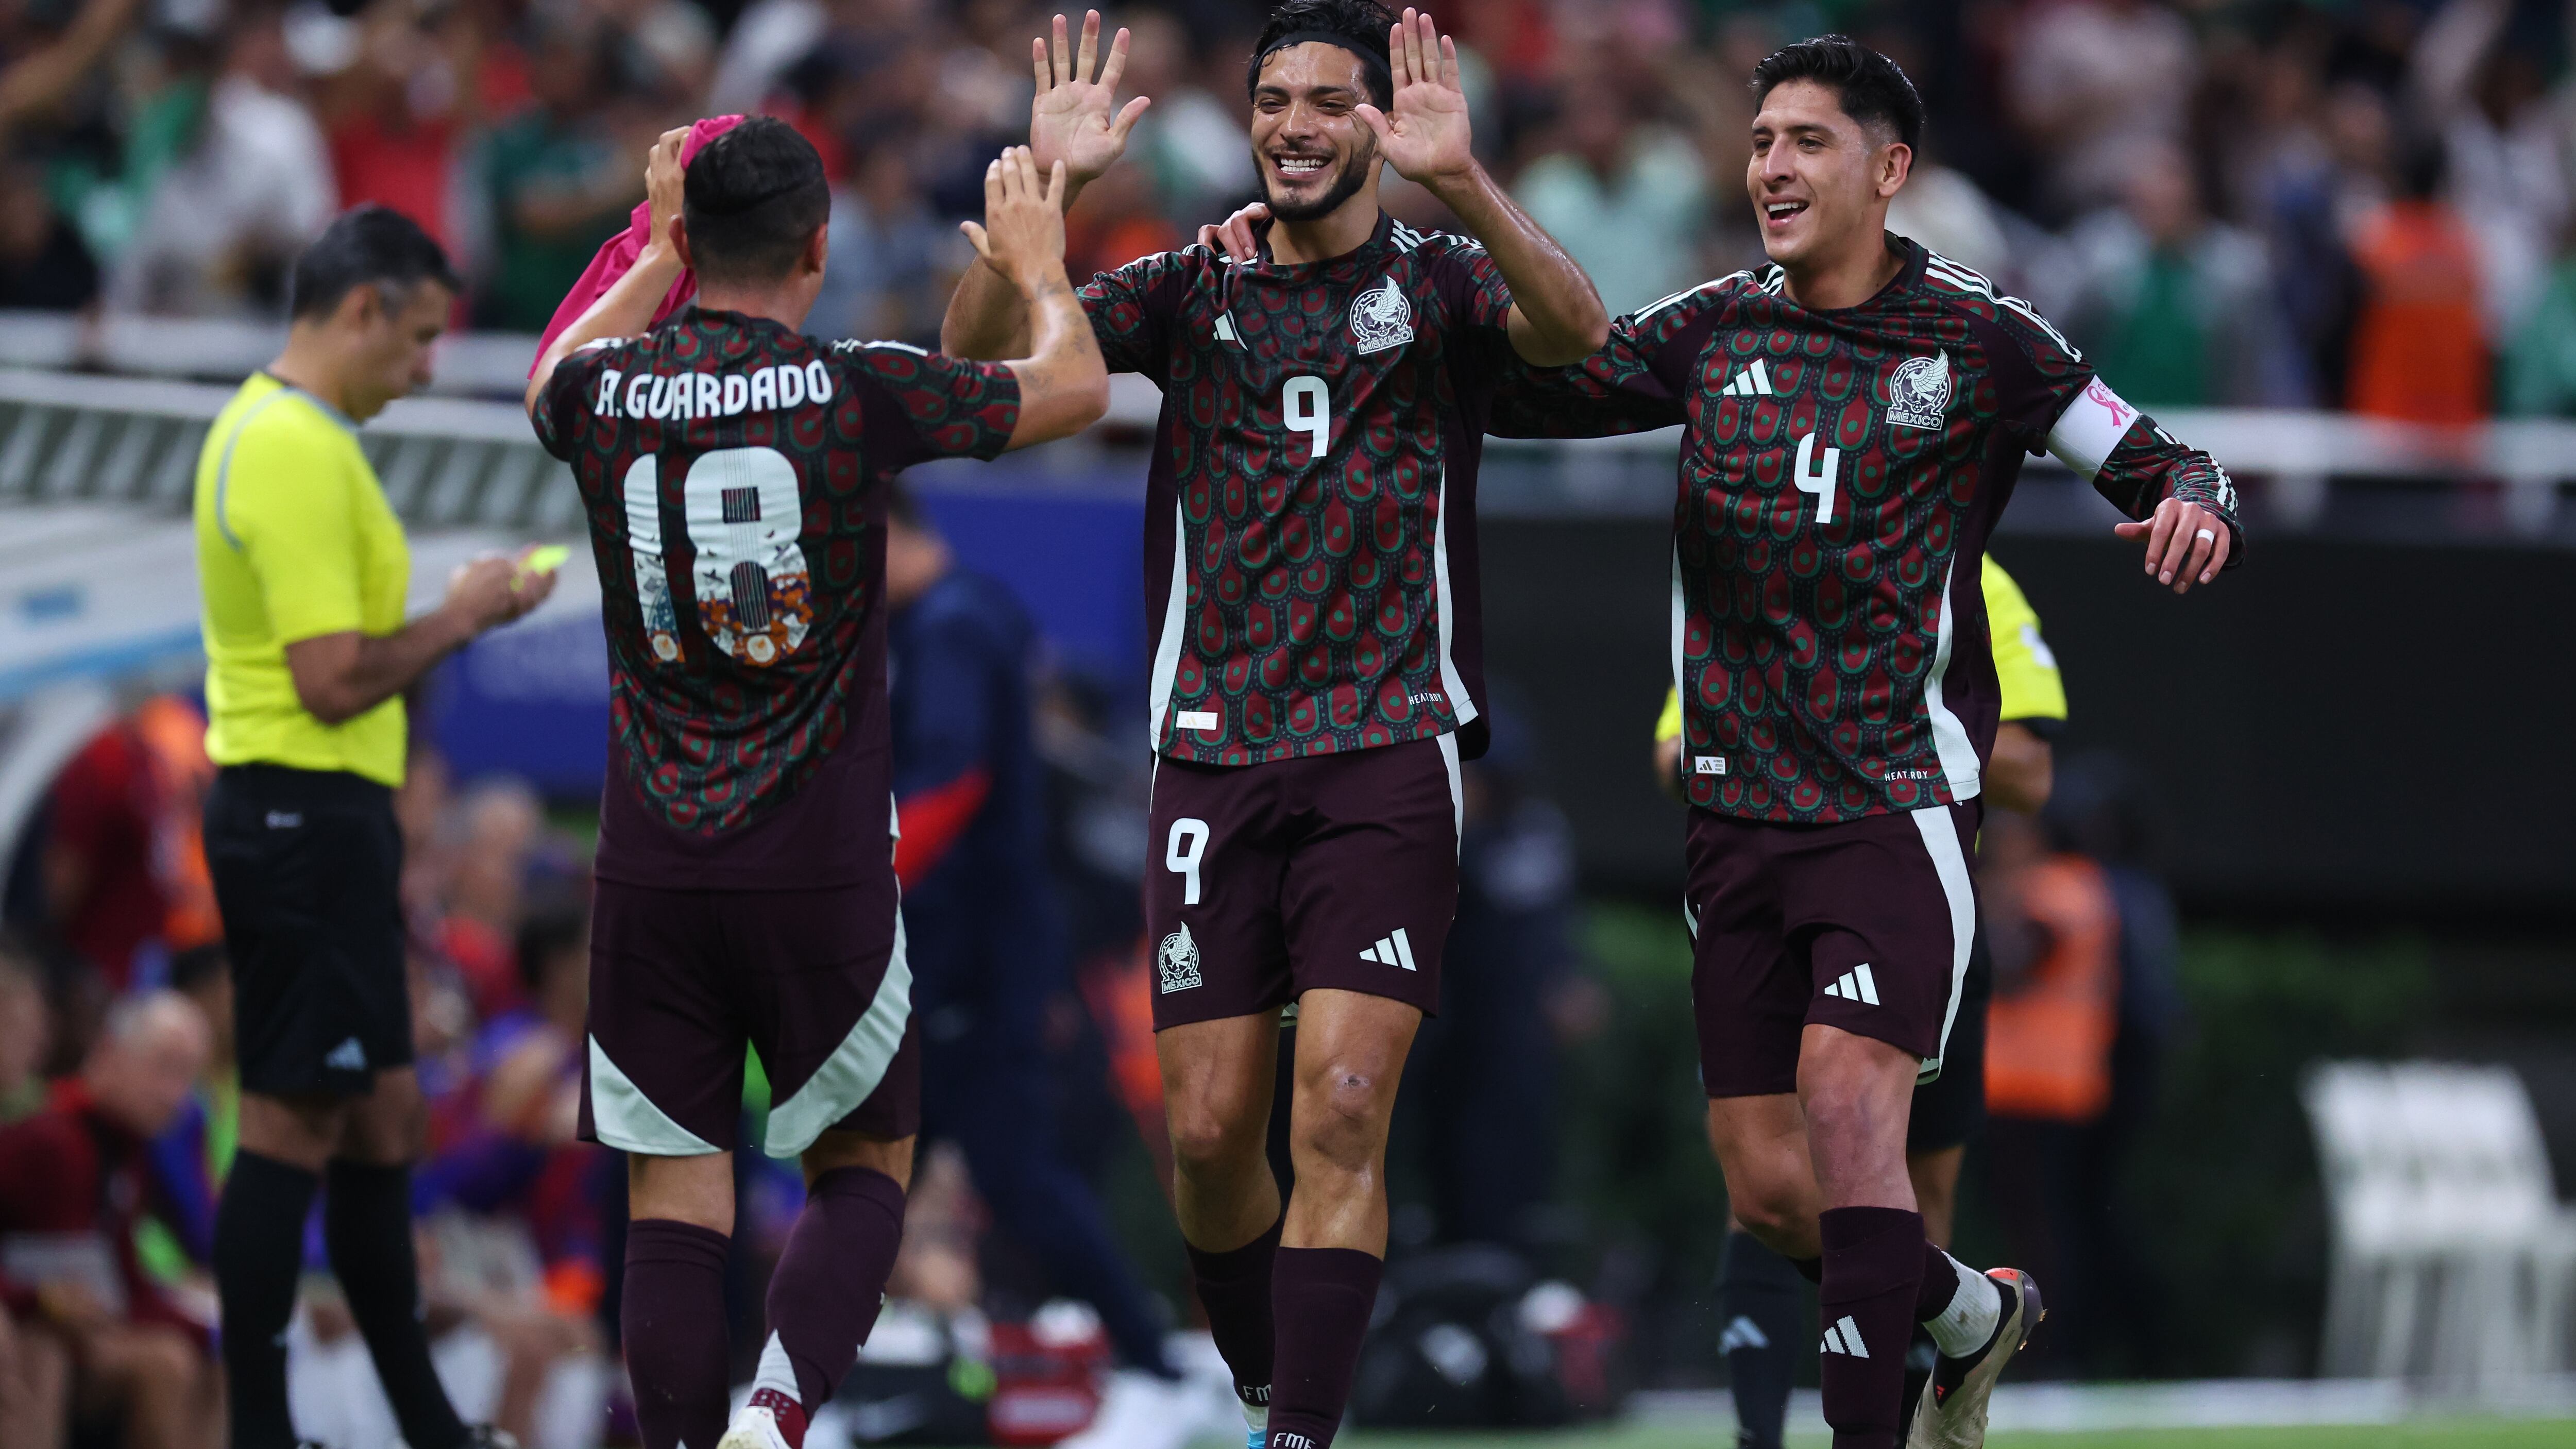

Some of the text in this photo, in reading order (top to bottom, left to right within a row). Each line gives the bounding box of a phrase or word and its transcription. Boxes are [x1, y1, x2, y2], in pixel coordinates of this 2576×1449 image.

[1360, 331, 1410, 352] MÉXICO
[1282, 376, 1330, 458] 9
[1889, 410, 1940, 427] MÉXICO
[1794, 432, 1840, 524] 4
[623, 446, 814, 668] 18
[1408, 693, 1442, 705] HEAT.RDY
[1885, 770, 1927, 781] HEAT.RDY
[1166, 818, 1210, 904] 9
[1163, 977, 1200, 991] MÉXICO
[1273, 1433, 1316, 1449] FMF
